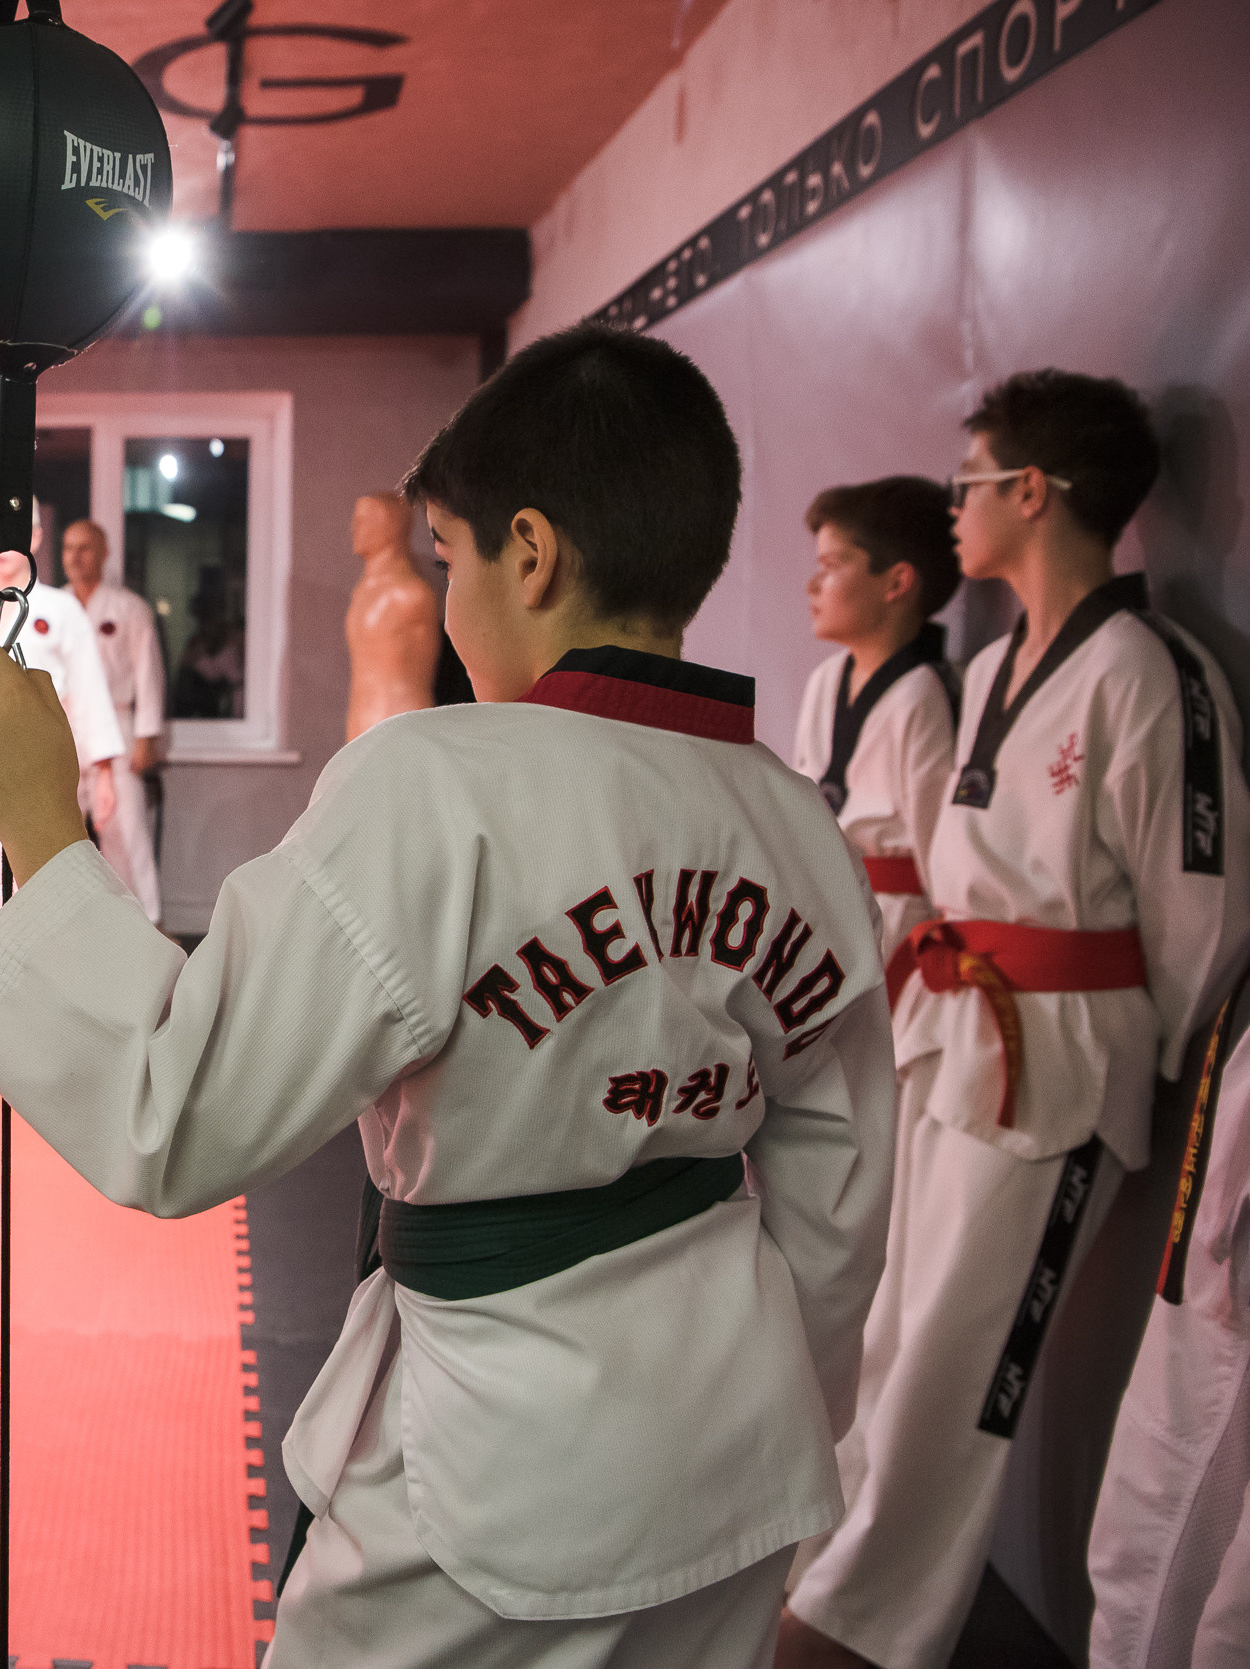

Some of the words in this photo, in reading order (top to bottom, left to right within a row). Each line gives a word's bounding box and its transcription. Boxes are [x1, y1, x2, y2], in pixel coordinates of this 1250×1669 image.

[61, 129, 155, 207] EVERLAST
[736, 109, 883, 260] ТОЛЬКО
[915, 0, 1126, 139] СПОР
